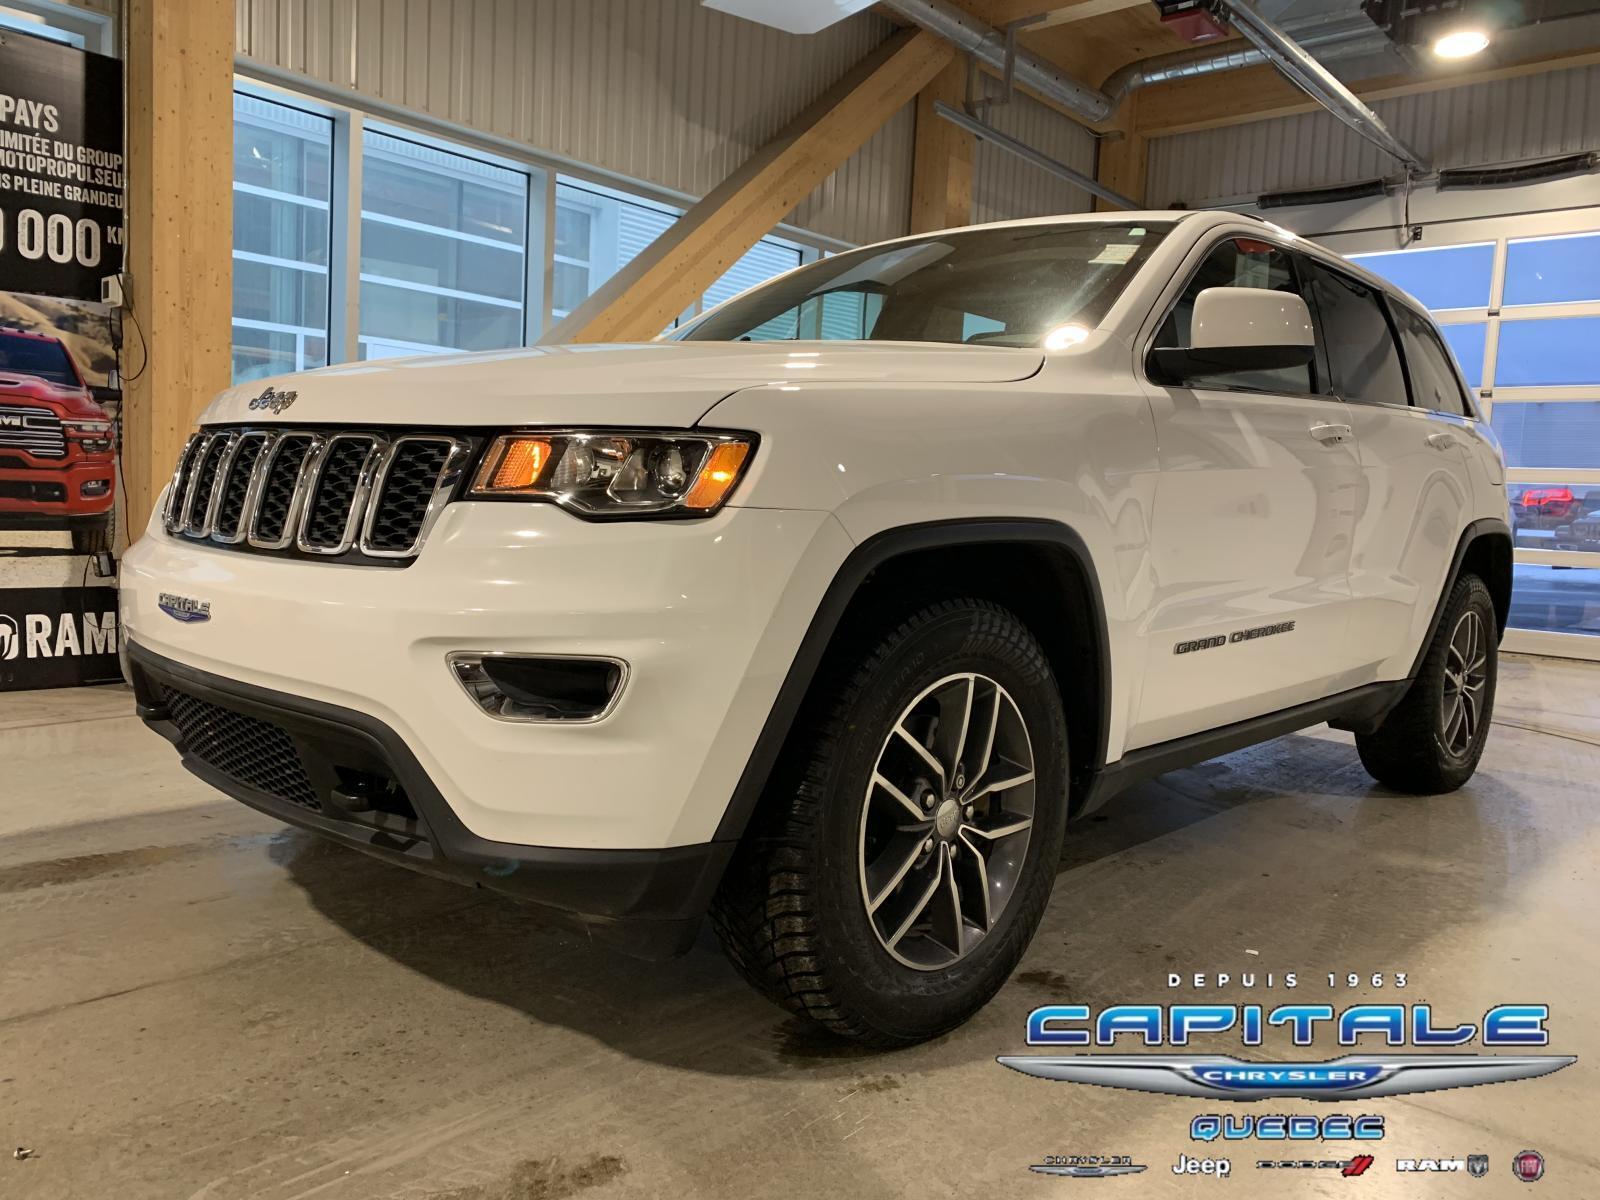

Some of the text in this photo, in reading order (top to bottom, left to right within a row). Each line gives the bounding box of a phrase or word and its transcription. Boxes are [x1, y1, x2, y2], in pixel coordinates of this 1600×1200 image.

[0, 94, 58, 132] PAYS
[54, 141, 73, 161] DU
[14, 176, 62, 199] PLEINE
[17, 208, 100, 267] 000
[249, 386, 298, 415] Jeep
[25, 611, 117, 659] RAM
[1174, 620, 1296, 655] GRAND CHEROKEE
